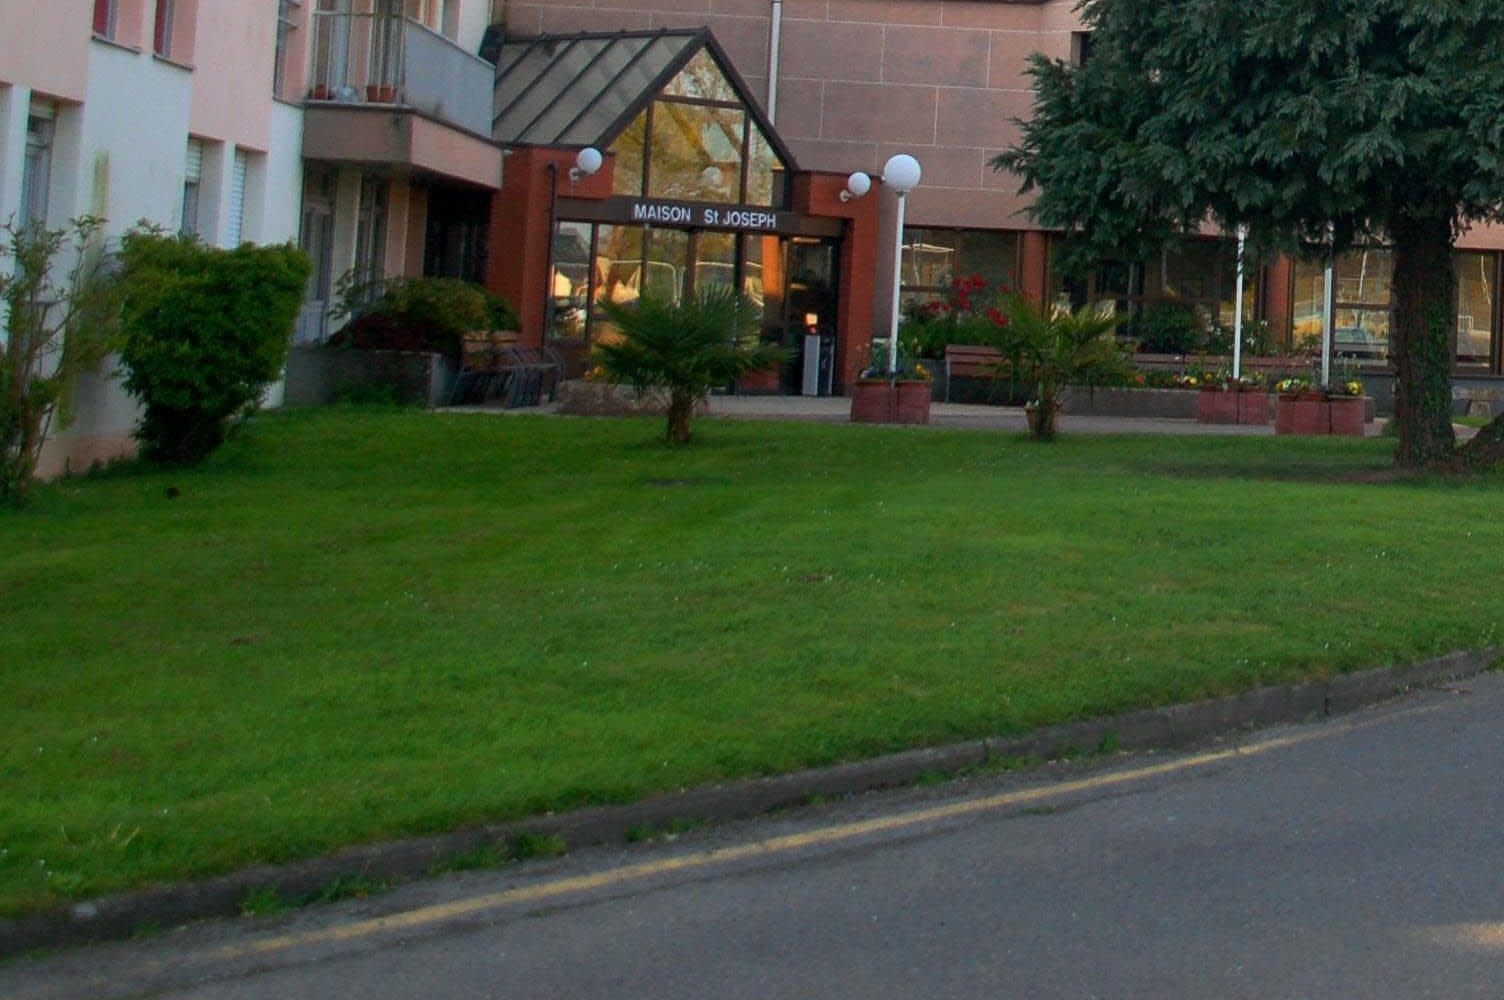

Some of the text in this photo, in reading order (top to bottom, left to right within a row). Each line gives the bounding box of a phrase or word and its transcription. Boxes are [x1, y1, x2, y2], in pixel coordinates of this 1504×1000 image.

[633, 203, 777, 228] MAISON St JOSEPH
